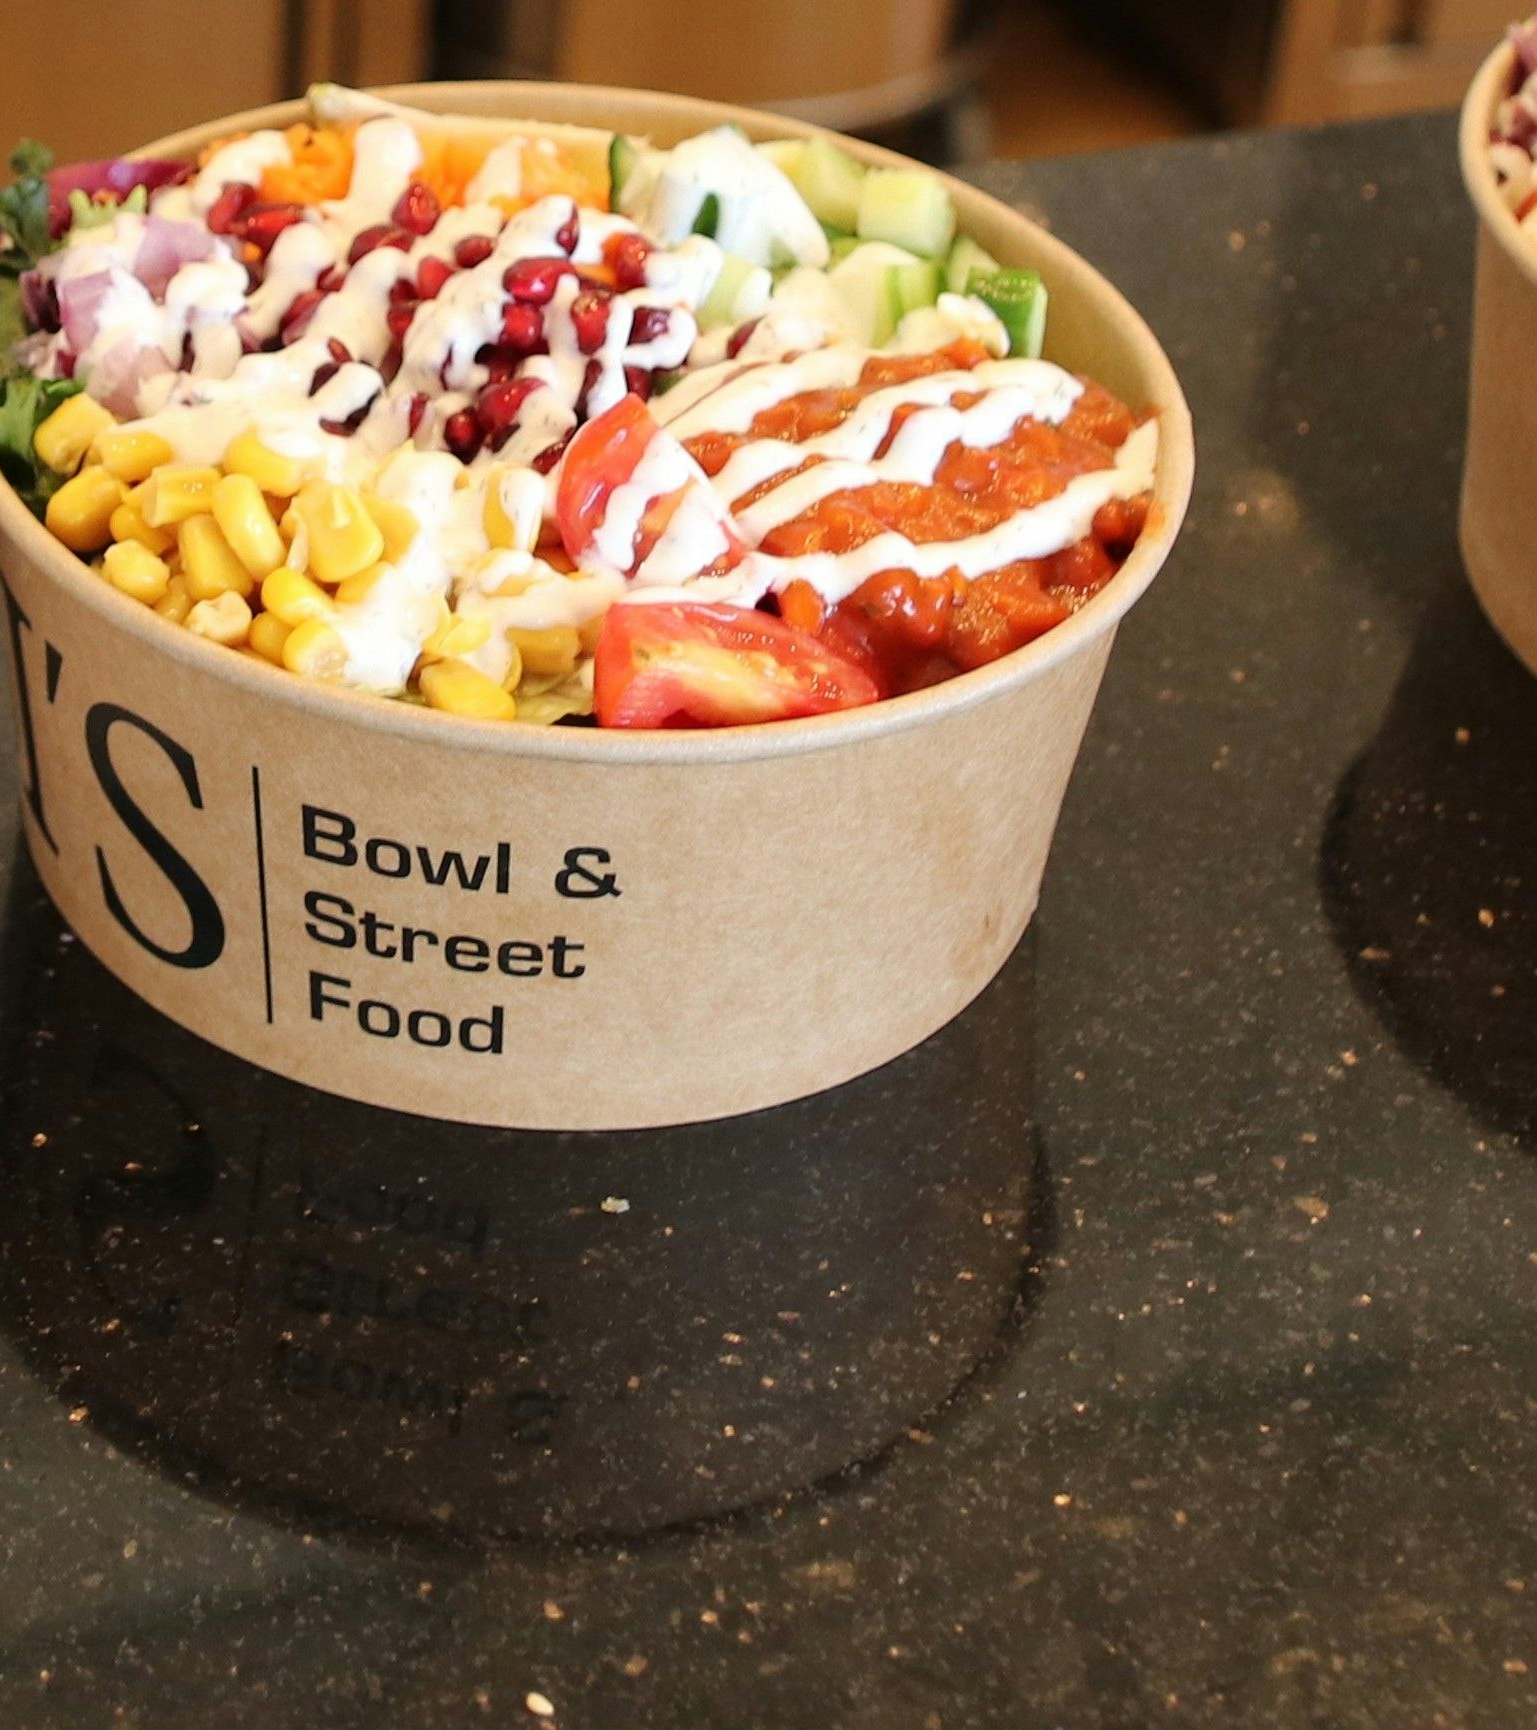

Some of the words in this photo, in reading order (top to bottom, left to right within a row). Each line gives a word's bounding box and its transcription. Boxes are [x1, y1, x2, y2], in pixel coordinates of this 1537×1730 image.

[302, 804, 511, 894] Bowl
[554, 847, 623, 899] &
[304, 891, 586, 979] Street
[310, 971, 504, 1054] Food
